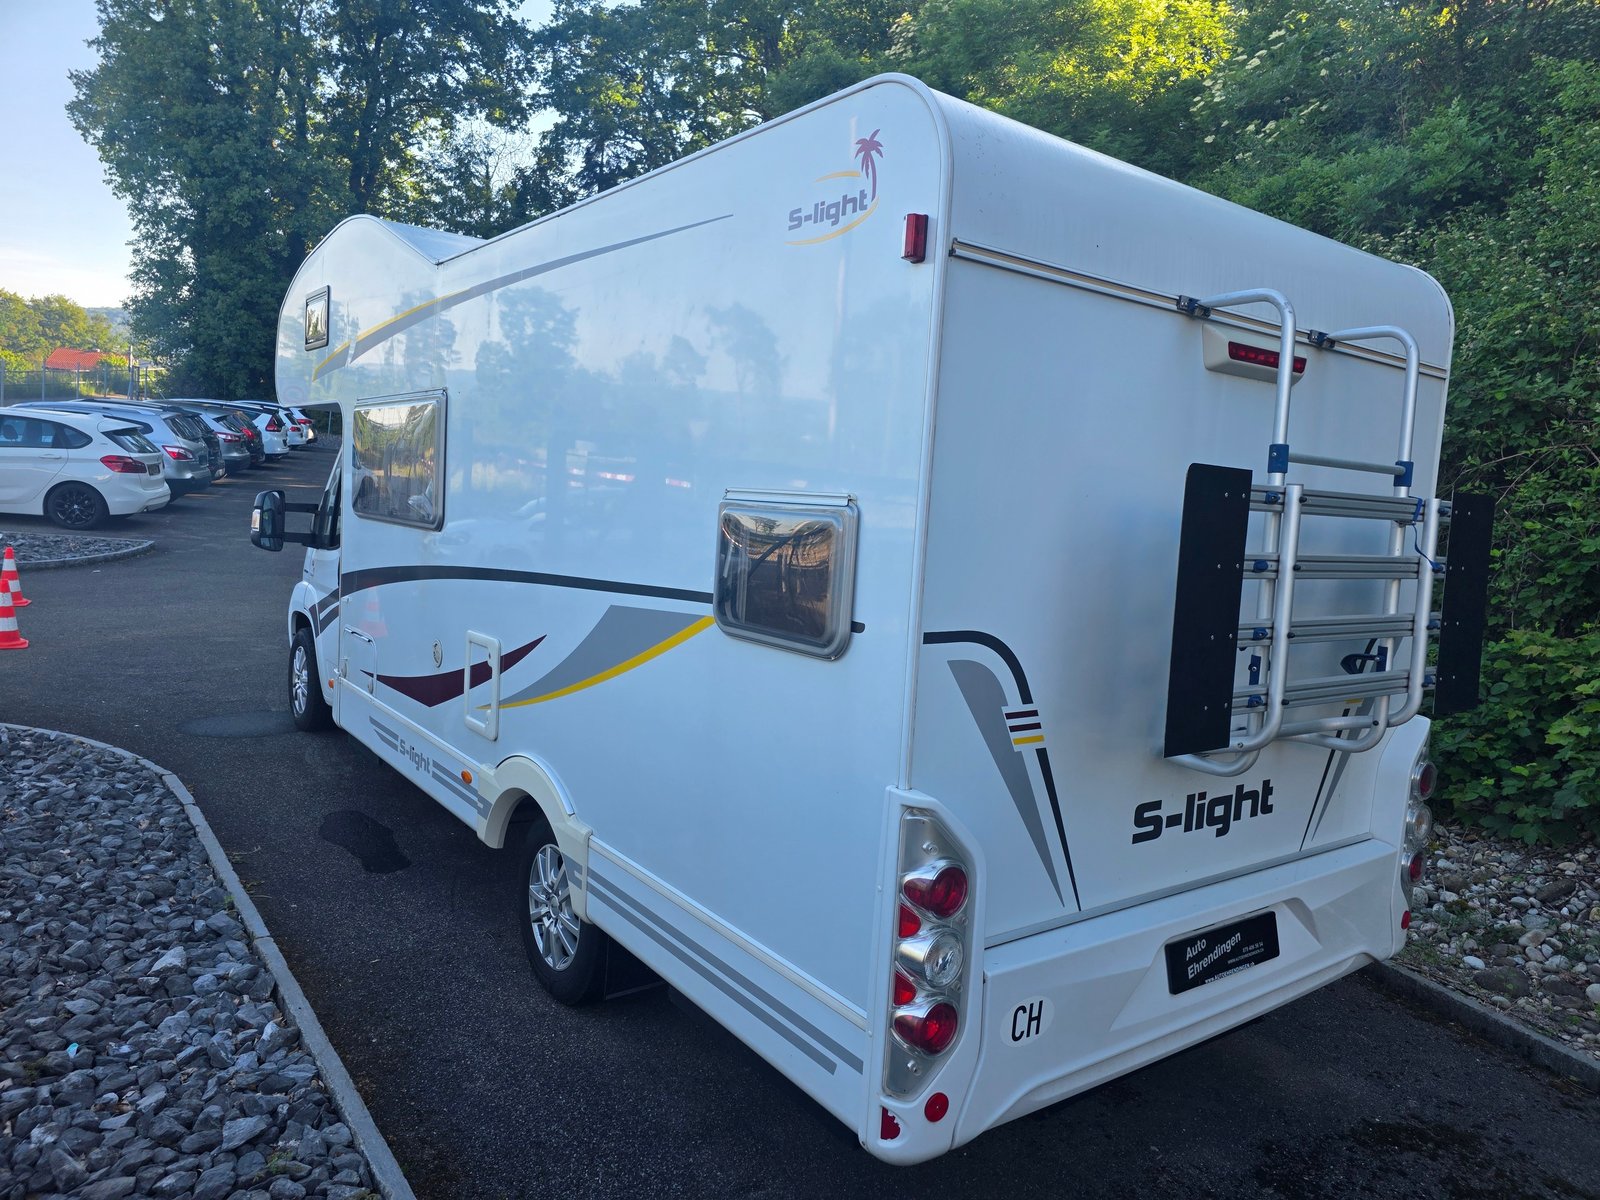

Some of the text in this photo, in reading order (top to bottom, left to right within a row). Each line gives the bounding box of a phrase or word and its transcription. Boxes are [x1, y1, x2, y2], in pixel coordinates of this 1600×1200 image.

[788, 189, 868, 231] S-light
[399, 738, 431, 774] S-light
[1131, 779, 1274, 845] S-light
[1186, 938, 1207, 961] Auto
[1187, 931, 1241, 980] Ehrendingen
[1011, 1000, 1044, 1042] CH
